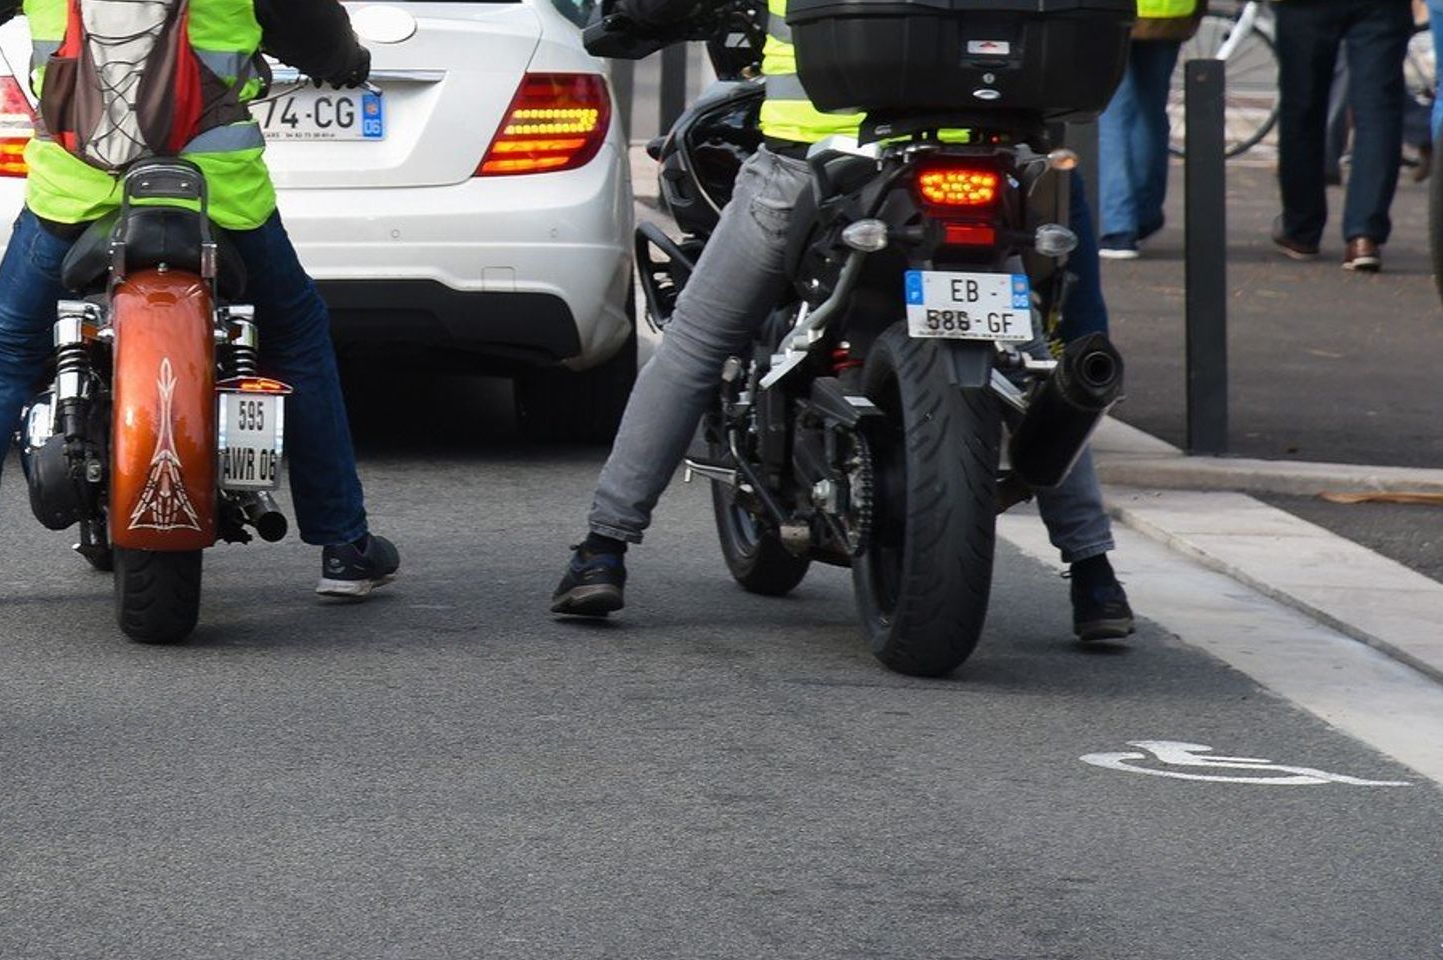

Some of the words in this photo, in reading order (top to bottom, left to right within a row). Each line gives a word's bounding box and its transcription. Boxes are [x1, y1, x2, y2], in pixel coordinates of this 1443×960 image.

[238, 400, 264, 431] 595
[223, 446, 255, 480] AWR
[259, 448, 276, 481] 06
